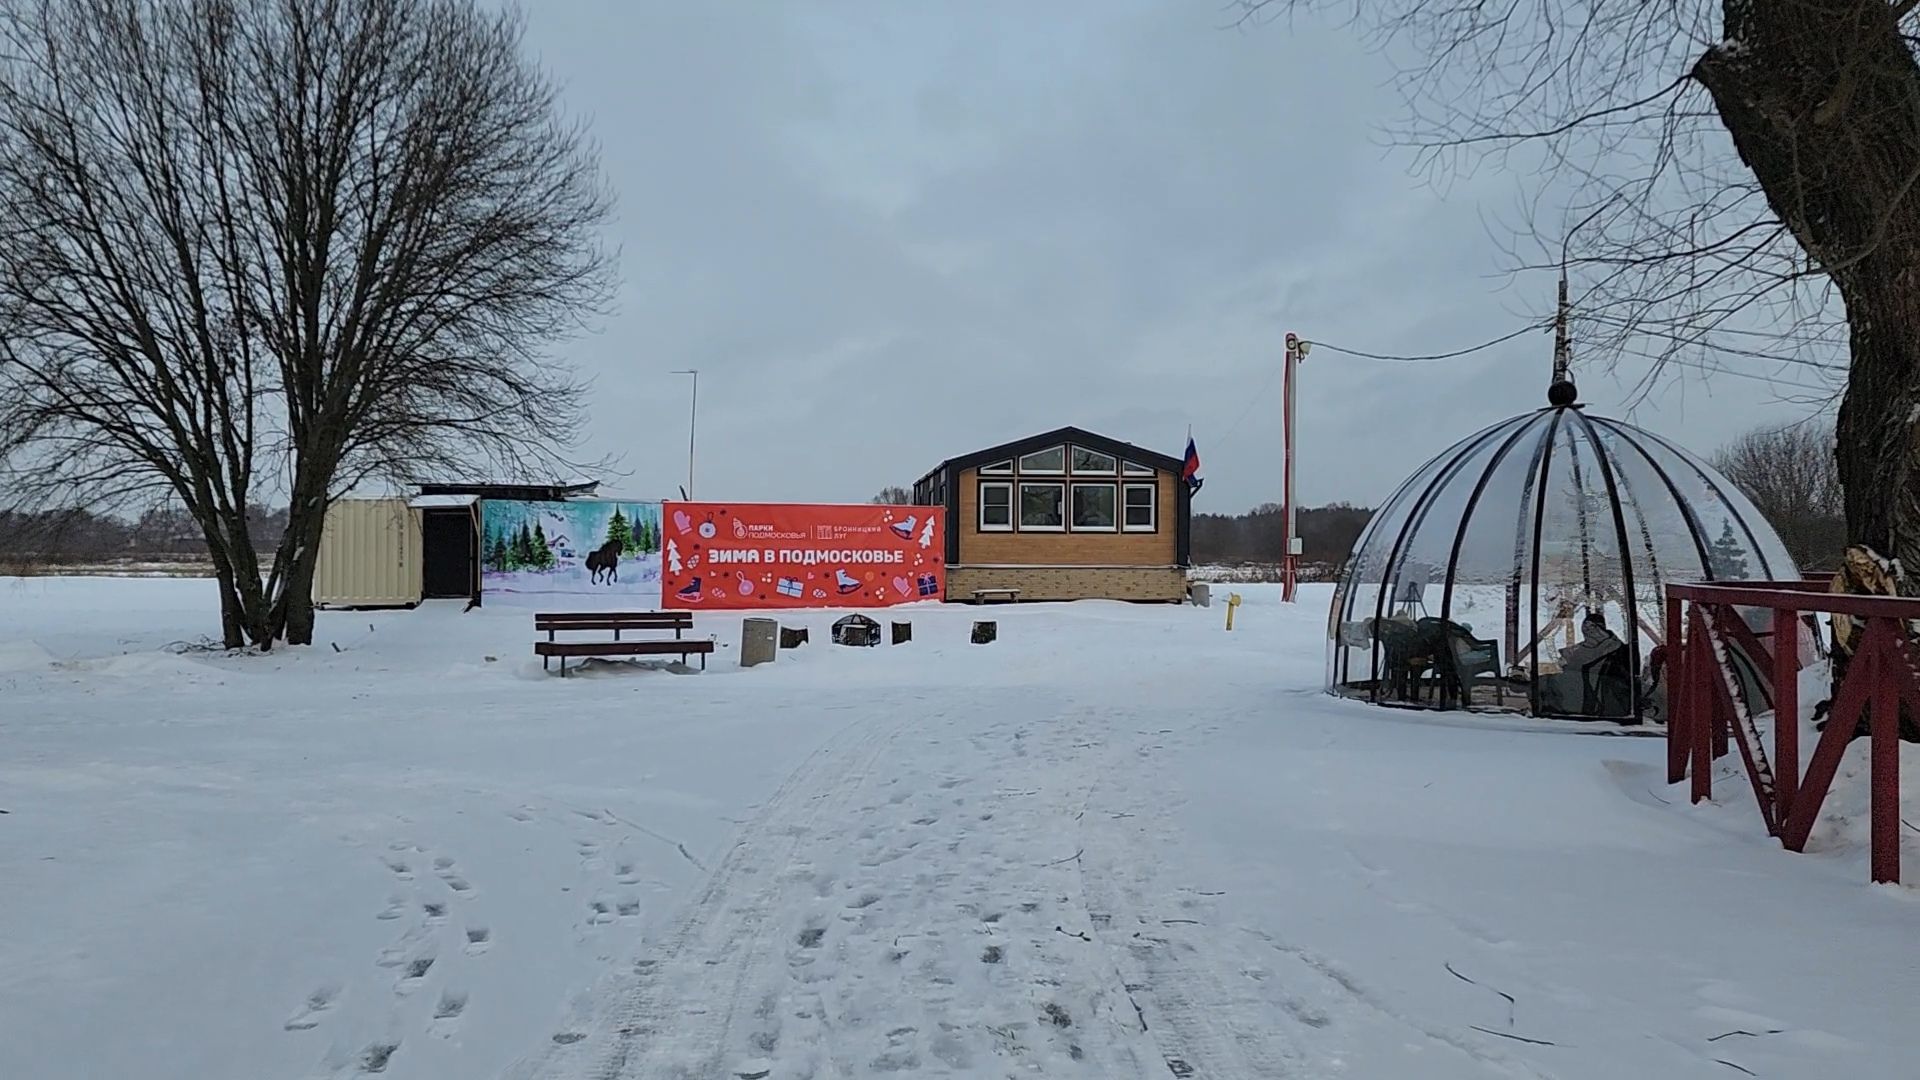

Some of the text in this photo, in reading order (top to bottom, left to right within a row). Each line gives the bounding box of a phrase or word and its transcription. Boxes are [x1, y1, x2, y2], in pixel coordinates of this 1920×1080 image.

[708, 549, 904, 565] ЗИМА В ПОДМОСКОВЬЕ
